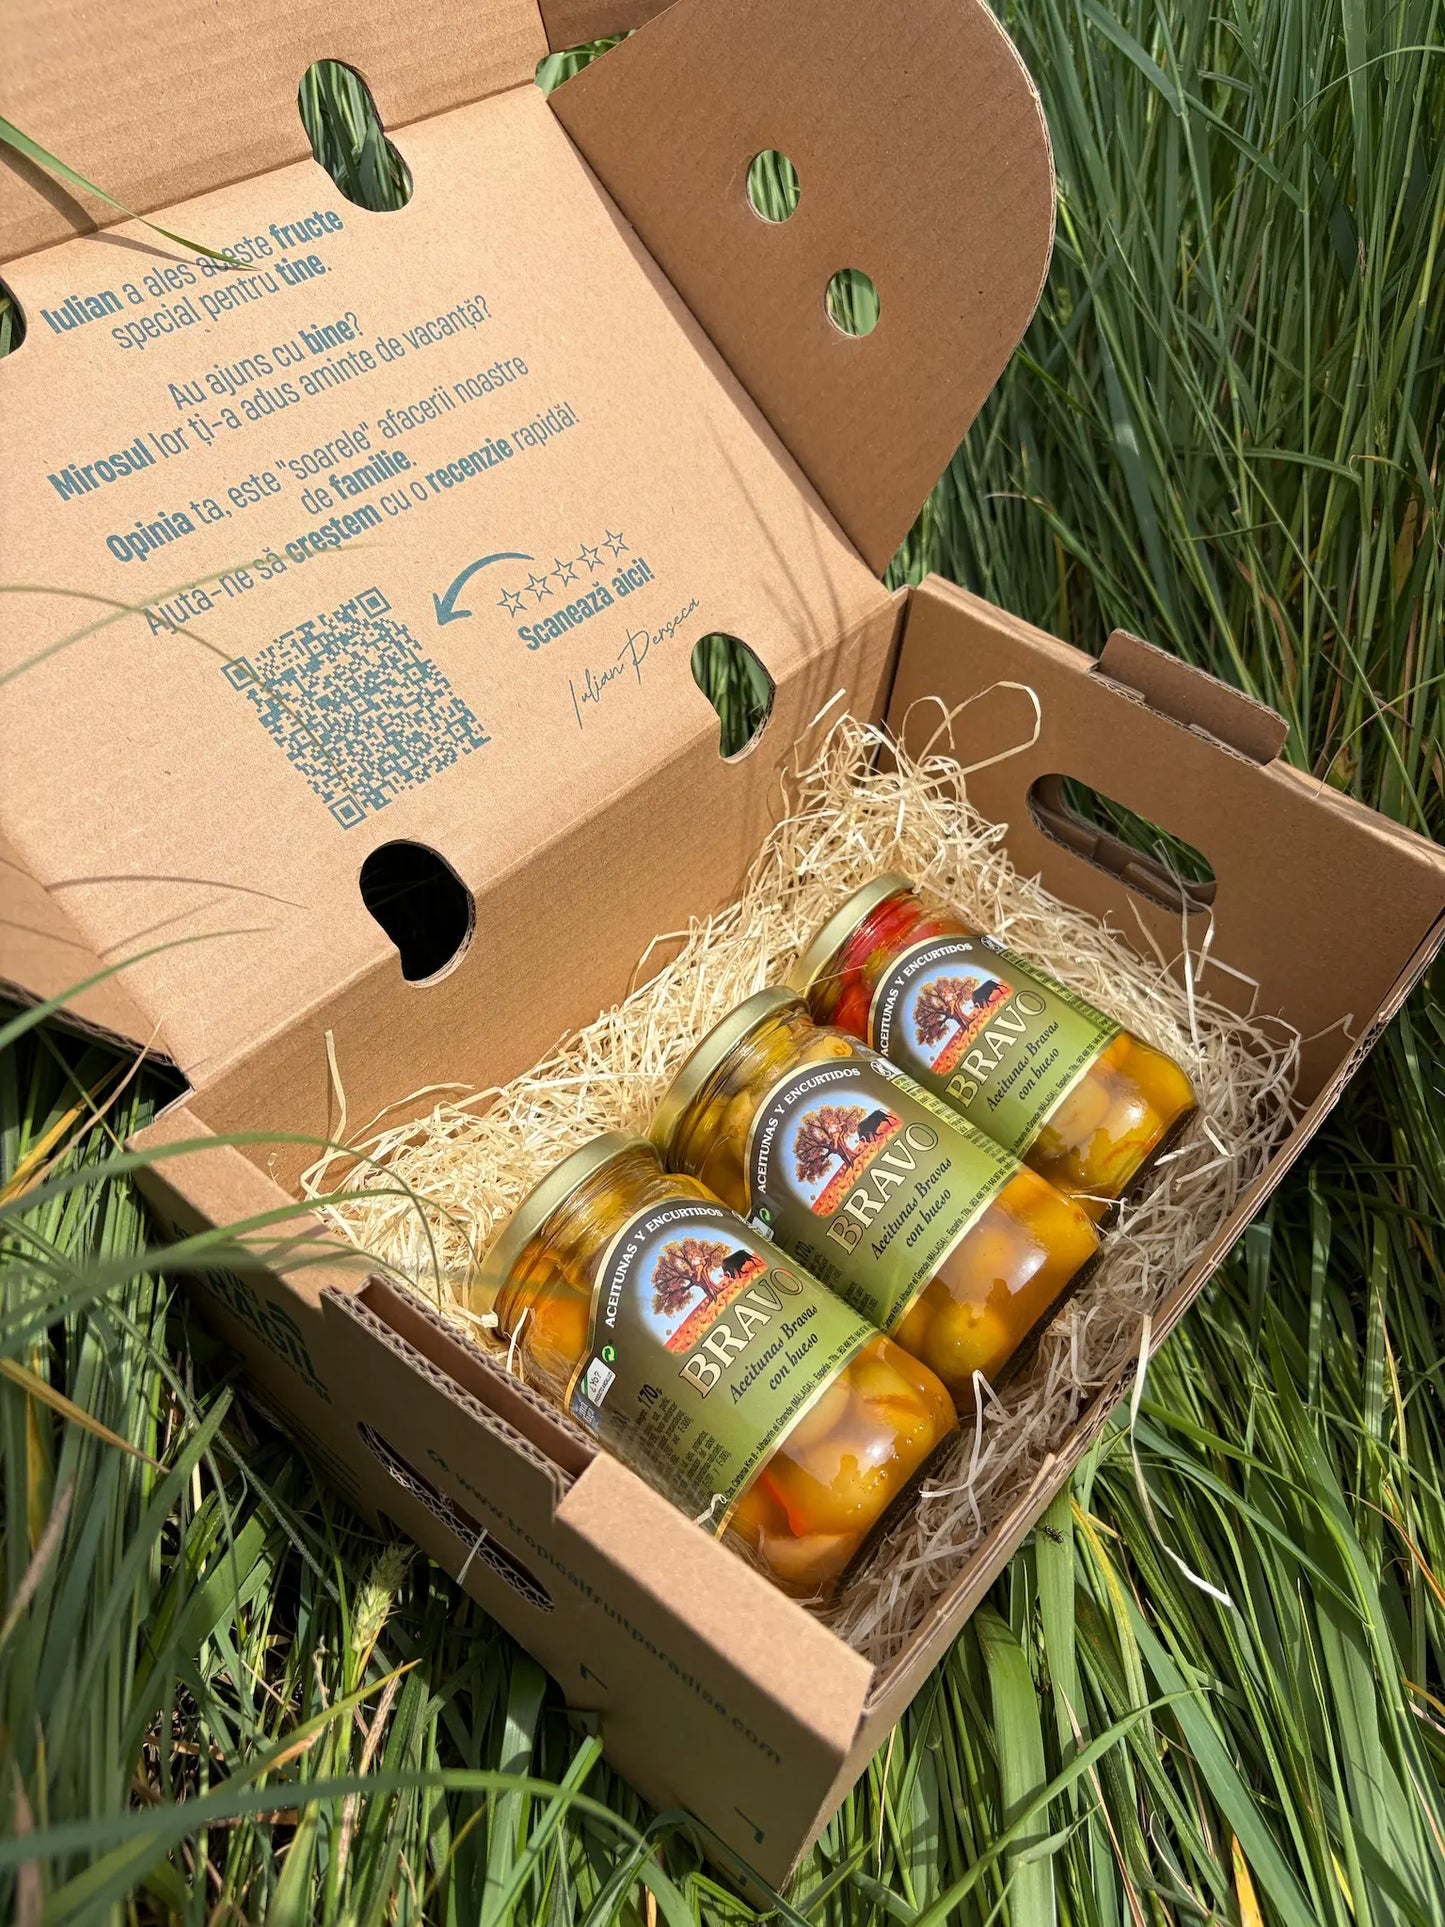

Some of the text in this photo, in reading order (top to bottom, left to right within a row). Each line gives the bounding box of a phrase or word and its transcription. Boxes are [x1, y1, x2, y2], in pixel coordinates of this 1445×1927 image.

[40, 290, 124, 334] Iulian
[122, 283, 144, 304] a
[143, 264, 197, 297] ales
[269, 210, 344, 249] fructe
[112, 255, 332, 350] special pentru tine.
[47, 295, 491, 501] Mirosul lor ți-a adus aminte de vacanță?
[168, 312, 362, 411] Au ajuns cu bine?
[106, 358, 528, 562] Opinia ta, este "soarele" afacerii noastre
[255, 548, 287, 580] să
[285, 504, 383, 563] creștem
[380, 490, 412, 516] cu
[410, 481, 428, 501] o
[425, 439, 514, 493] recenzie
[512, 402, 579, 449] rapidă!
[301, 449, 417, 515] de familie.
[517, 557, 655, 651] Scanează aici!
[879, 942, 973, 1057] ACEITUNAS Y ENCURTIDOS
[945, 990, 1046, 1108] BRAVO
[984, 1054, 1031, 1113] Aceitunas
[1025, 1019, 1059, 1063] Bravas
[1017, 1079, 1036, 1100] con
[757, 1068, 861, 1194] ACEITUNAS Y ENCURTIDOS
[826, 1122, 938, 1256] BRAVO
[870, 1194, 921, 1261] Aceitunas
[913, 1156, 952, 1206] Bravas
[904, 1224, 926, 1248] con
[605, 1207, 723, 1328] ACEITUNAS Y ENCURTIDOS
[913, 1260, 931, 1279] Grande
[925, 1237, 948, 1263] (MÁLAGA)
[946, 1217, 963, 1236] España
[678, 1267, 804, 1398] BRAVO
[728, 1303, 818, 1404] Aceitunas Bravas
[768, 1368, 791, 1392] con
[813, 1362, 831, 1381] España
[754, 1428, 776, 1452] Alhaurín
[771, 1423, 780, 1431] el
[774, 1404, 795, 1426] Grande
[789, 1380, 815, 1408] (MÁLAGA)
[743, 1456, 755, 1468] Km
